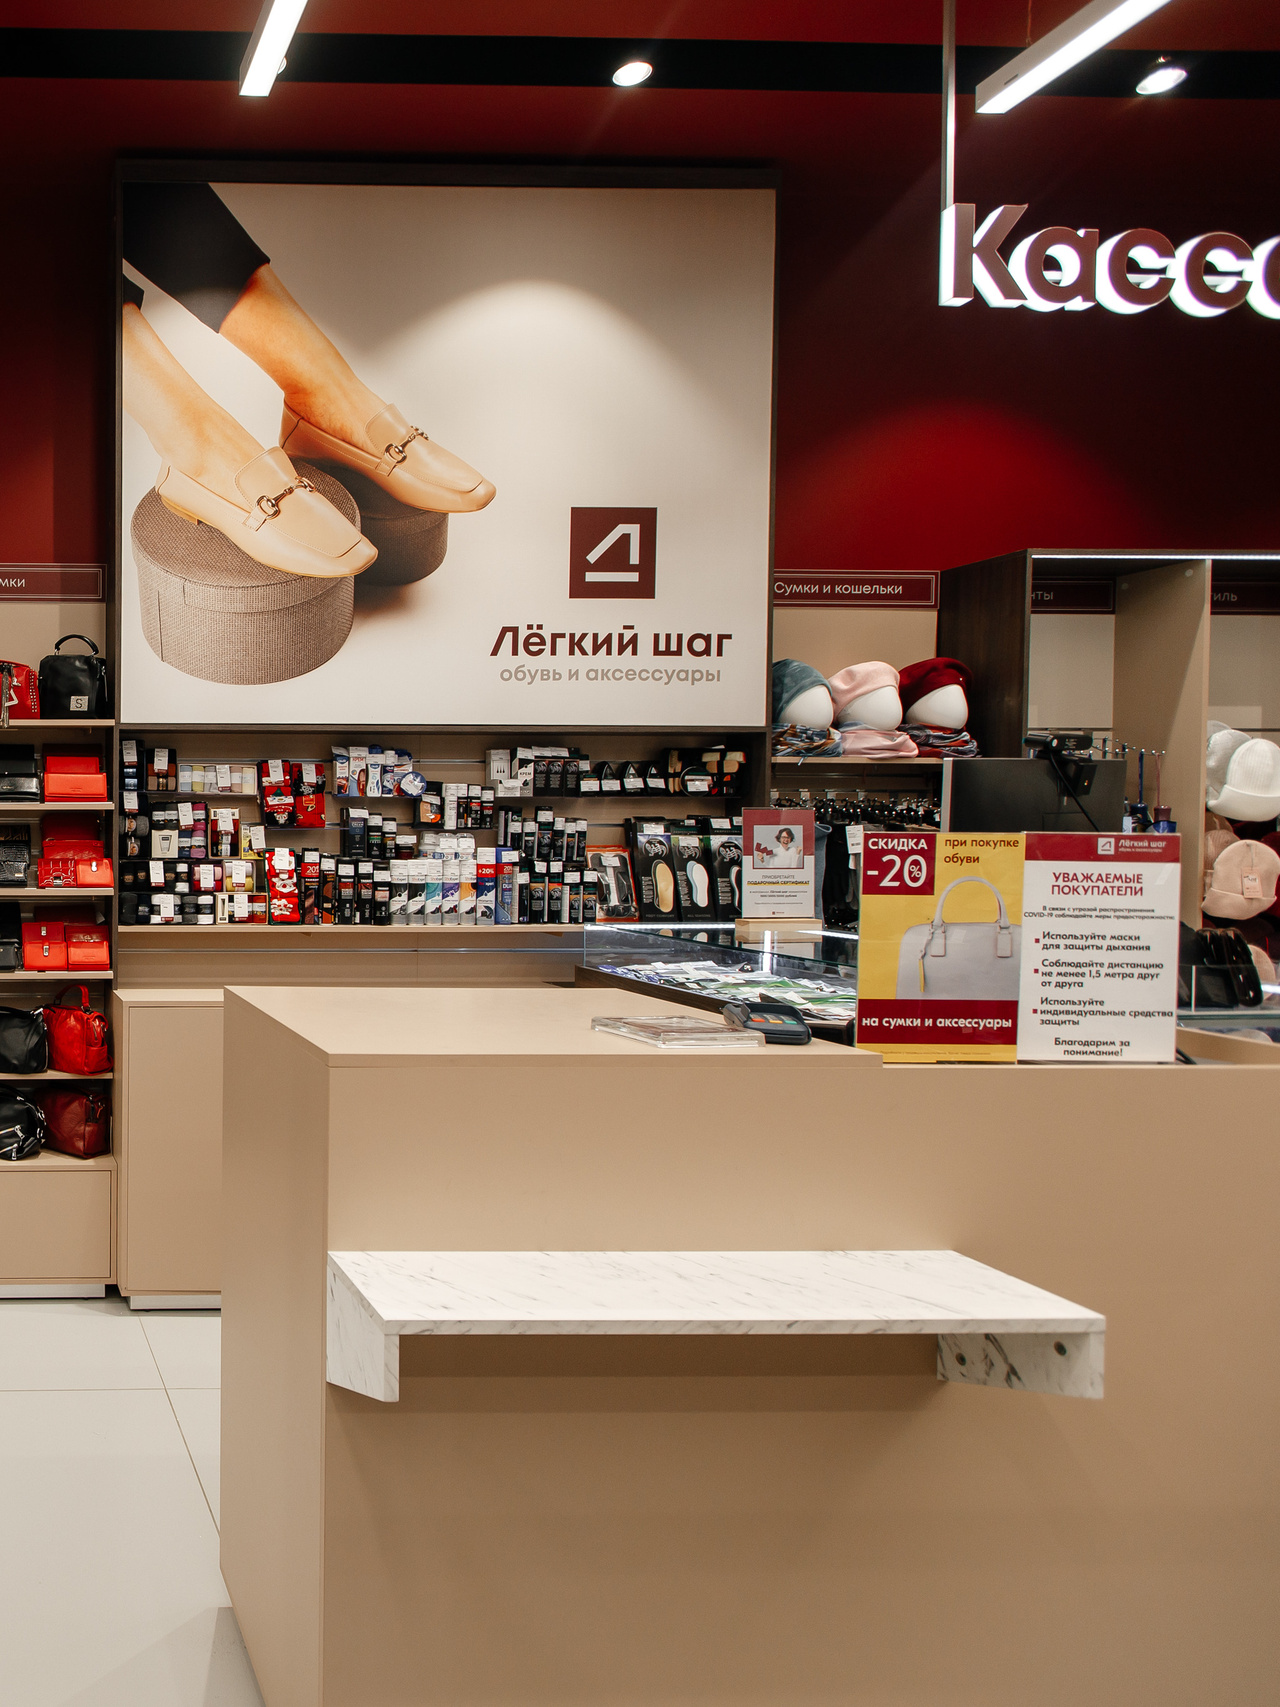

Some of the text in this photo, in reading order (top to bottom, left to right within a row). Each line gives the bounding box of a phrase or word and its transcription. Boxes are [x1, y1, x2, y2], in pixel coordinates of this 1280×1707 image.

[938, 202, 1280, 321] Касс
[773, 581, 903, 596] Сумки и кошельки
[1210, 591, 1238, 602] иль
[490, 623, 733, 657] Лёгкий шаг
[499, 664, 721, 686] обувь и аксессуары
[868, 838, 928, 851] СКИДКА
[944, 839, 1019, 850] при покупке
[1118, 839, 1167, 848] Лёгкий шаг
[943, 853, 980, 866] обуви
[478, 867, 495, 875] +20%
[1052, 872, 1143, 884] УВАЖАЕМЫЕ
[1051, 885, 1144, 897] ПОКУПАТЕЛИ
[1042, 931, 1107, 942] Используйте
[1041, 943, 1151, 952] для защиты дыхания
[1041, 958, 1164, 970] Соблюдайте дистанцию
[1041, 969, 1160, 981] не менее 1,5 метра друг
[1054, 981, 1084, 989] друга
[1040, 996, 1105, 1007] Используйте
[1039, 1008, 1174, 1018] индивидуальные средства
[861, 1017, 1012, 1030] на сумки и аксессуары
[1039, 1017, 1080, 1026] защиты
[1054, 1037, 1130, 1048] Благодарим за
[1063, 1048, 1123, 1056] понимание!
